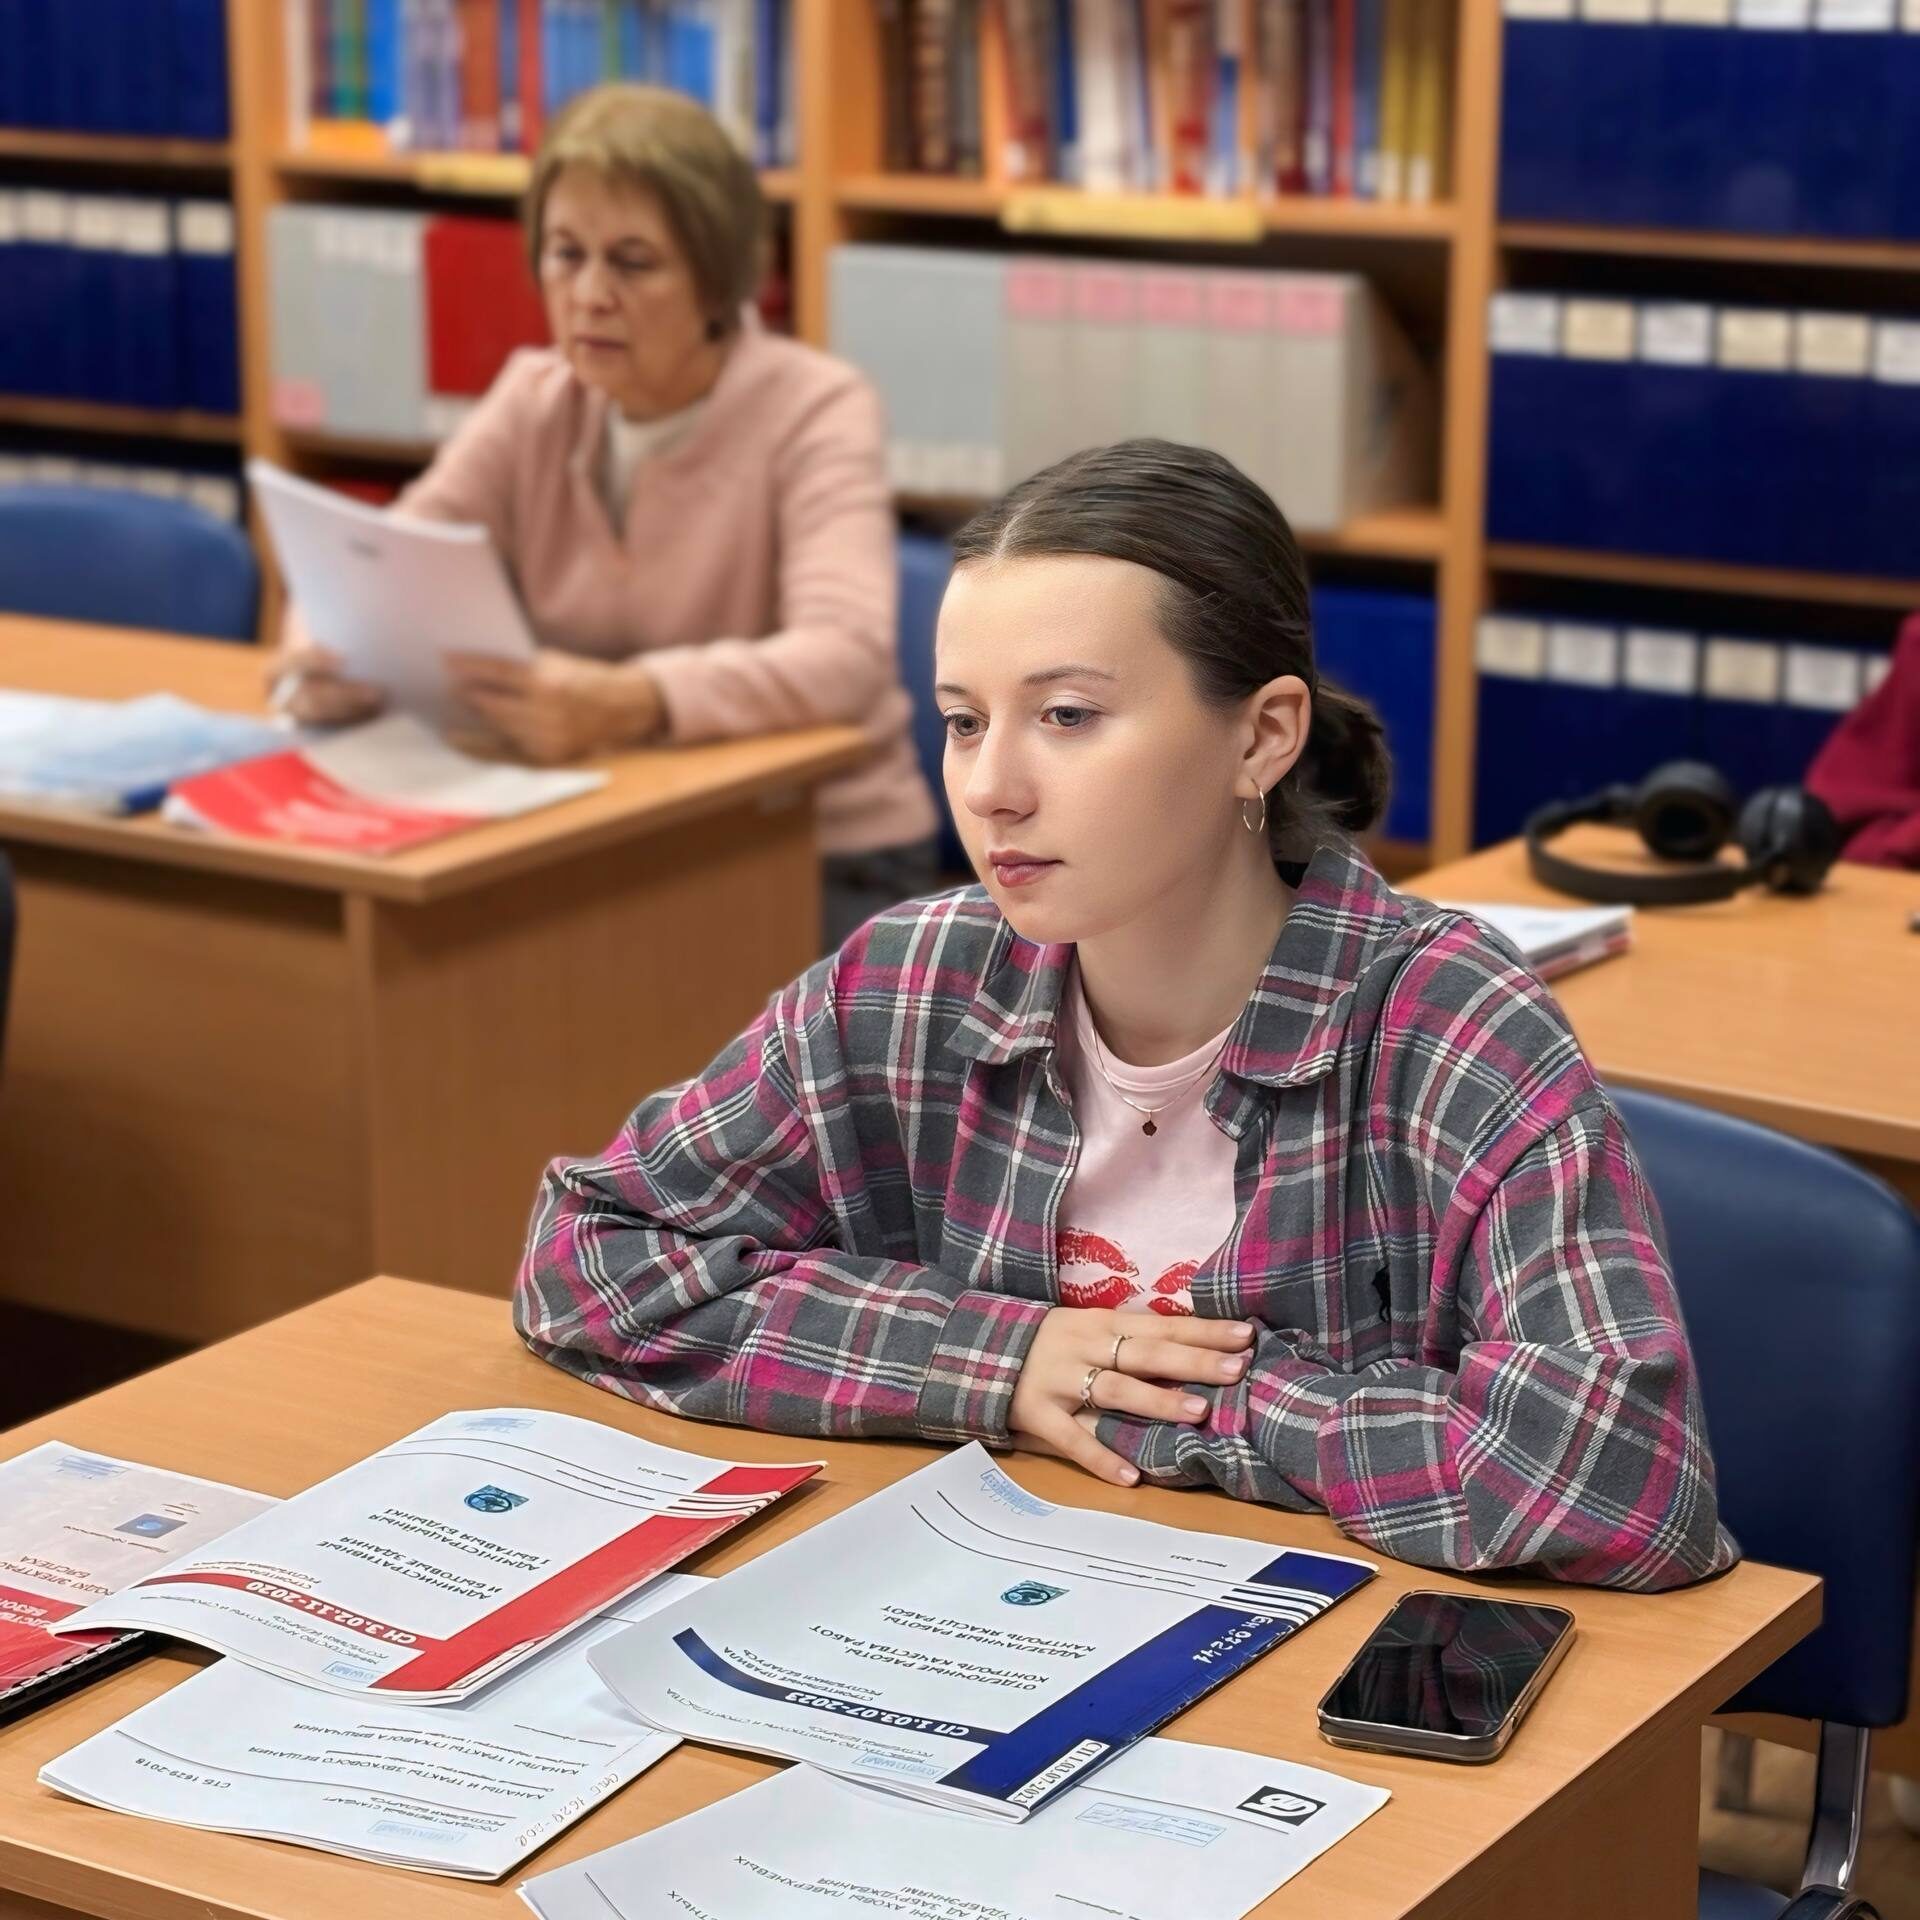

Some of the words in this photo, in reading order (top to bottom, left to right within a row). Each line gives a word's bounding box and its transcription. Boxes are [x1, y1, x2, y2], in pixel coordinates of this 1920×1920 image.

[383, 1507, 459, 1536] БУДЫНКІ
[339, 1536, 406, 1561] ЗДАНИЯ
[367, 1513, 540, 1572] АДМІНІСТРАЦЫЙНЫЯ
[459, 1532, 540, 1563] БЫТАВЫЯ
[316, 1539, 492, 1601] АДМИНИСТРАТИВНЫЕ
[409, 1558, 487, 1591] БЫТОВЫЕ
[245, 1580, 385, 1635] 3.02.11-2020
[879, 1603, 937, 1623] РАБОТ
[390, 1623, 418, 1644] СН
[807, 1623, 866, 1647] РАБОТ
[880, 1613, 953, 1637] РАБОТЫ.
[936, 1617, 1002, 1638] ЯКАСЦІ
[869, 1642, 954, 1667] КАЧЕСТВА
[954, 1631, 1087, 1660] АДДЗЕЛАЧНЫЯ
[1006, 1632, 1097, 1653] КАНТРОЛЬ
[722, 1646, 778, 1679] ПРАВИЛА
[743, 1648, 802, 1678] БЕЛАРУСЬ
[843, 1646, 916, 1668] РАБОТЫ.
[915, 1662, 1037, 1691] ОТДЕЛОЧНЫЕ
[957, 1661, 1050, 1684] КОНТРОЛЬ
[784, 1690, 935, 1731] 1.03.07-2023
[938, 1722, 970, 1737] СП
[247, 1746, 321, 1763] ВЕЩАНИЯ
[450, 1745, 505, 1763] ТРАКТЫ
[1077, 1741, 1104, 1765] СП
[135, 1759, 201, 1783] 1629-2018
[322, 1757, 406, 1776] ЗВУКОВОГО
[407, 1768, 464, 1787] ТРАКТЫ
[517, 1759, 580, 1776] КАНАЛЫ
[203, 1779, 232, 1790] СТБ
[1012, 1753, 1083, 1806] 1.03.07-2023
[480, 1785, 545, 1801] КАНАЛЫ
[733, 1855, 845, 1898] ПАВЕРХНЕВЫХ
[667, 1890, 717, 1920] ТНЫХ
[816, 1878, 941, 1911] ЗАБРУДЖВАННЯ
[849, 1892, 906, 1912] АХОВЫ
[946, 1907, 971, 1918] АД
